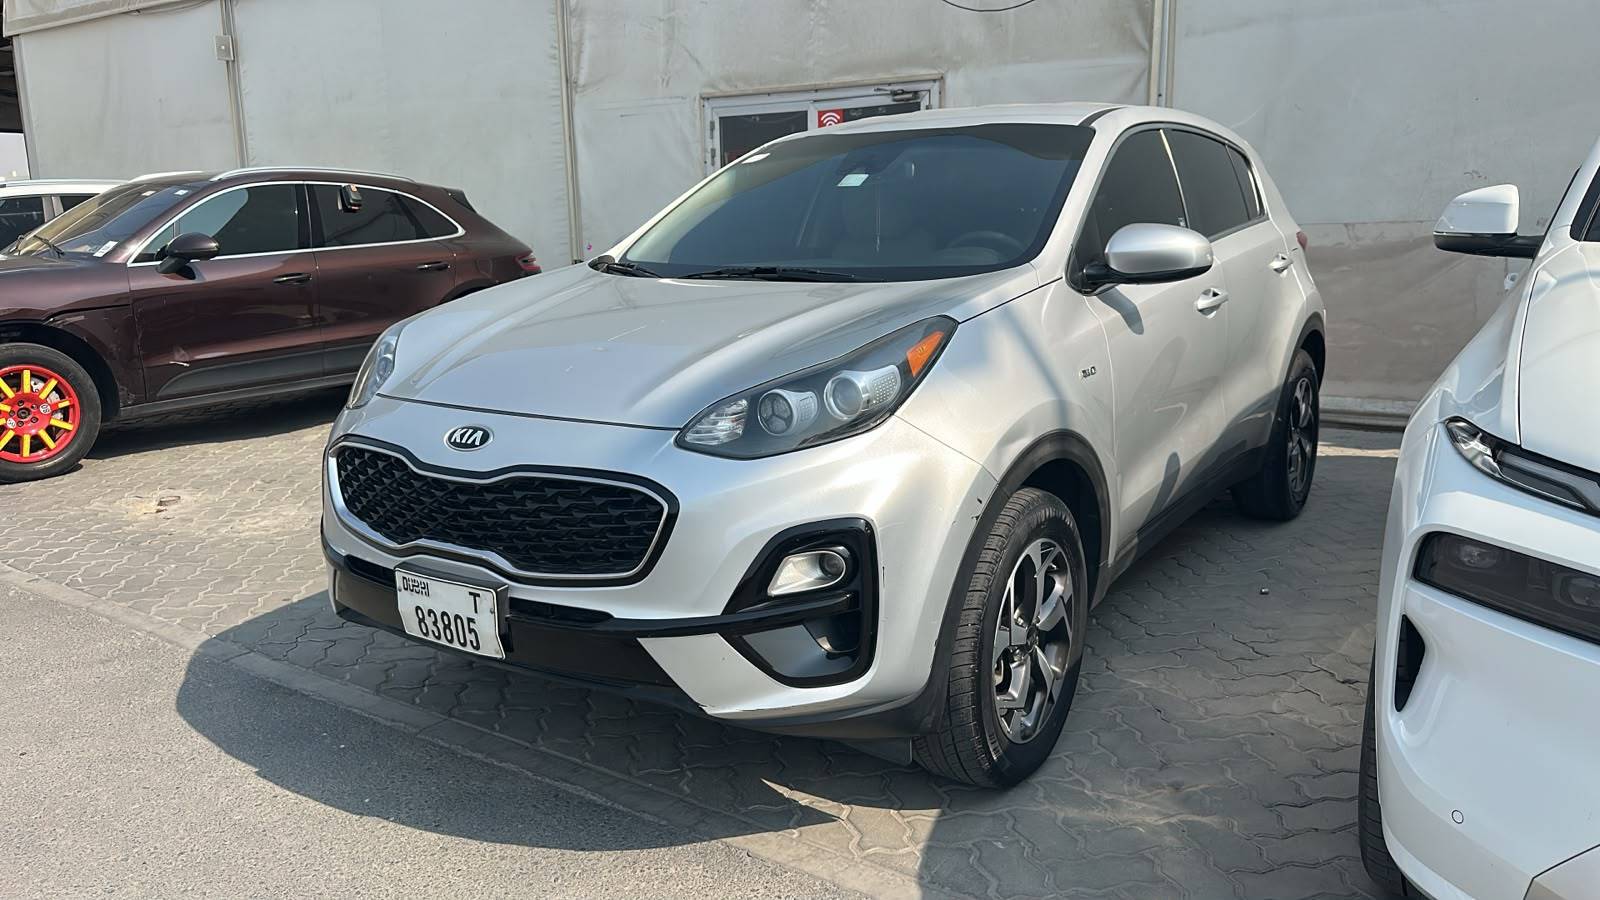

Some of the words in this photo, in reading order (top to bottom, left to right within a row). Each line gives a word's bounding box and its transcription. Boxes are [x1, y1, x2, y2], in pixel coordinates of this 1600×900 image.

[450, 428, 484, 446] KIA
[468, 592, 481, 614] T
[415, 605, 481, 651] 83805
